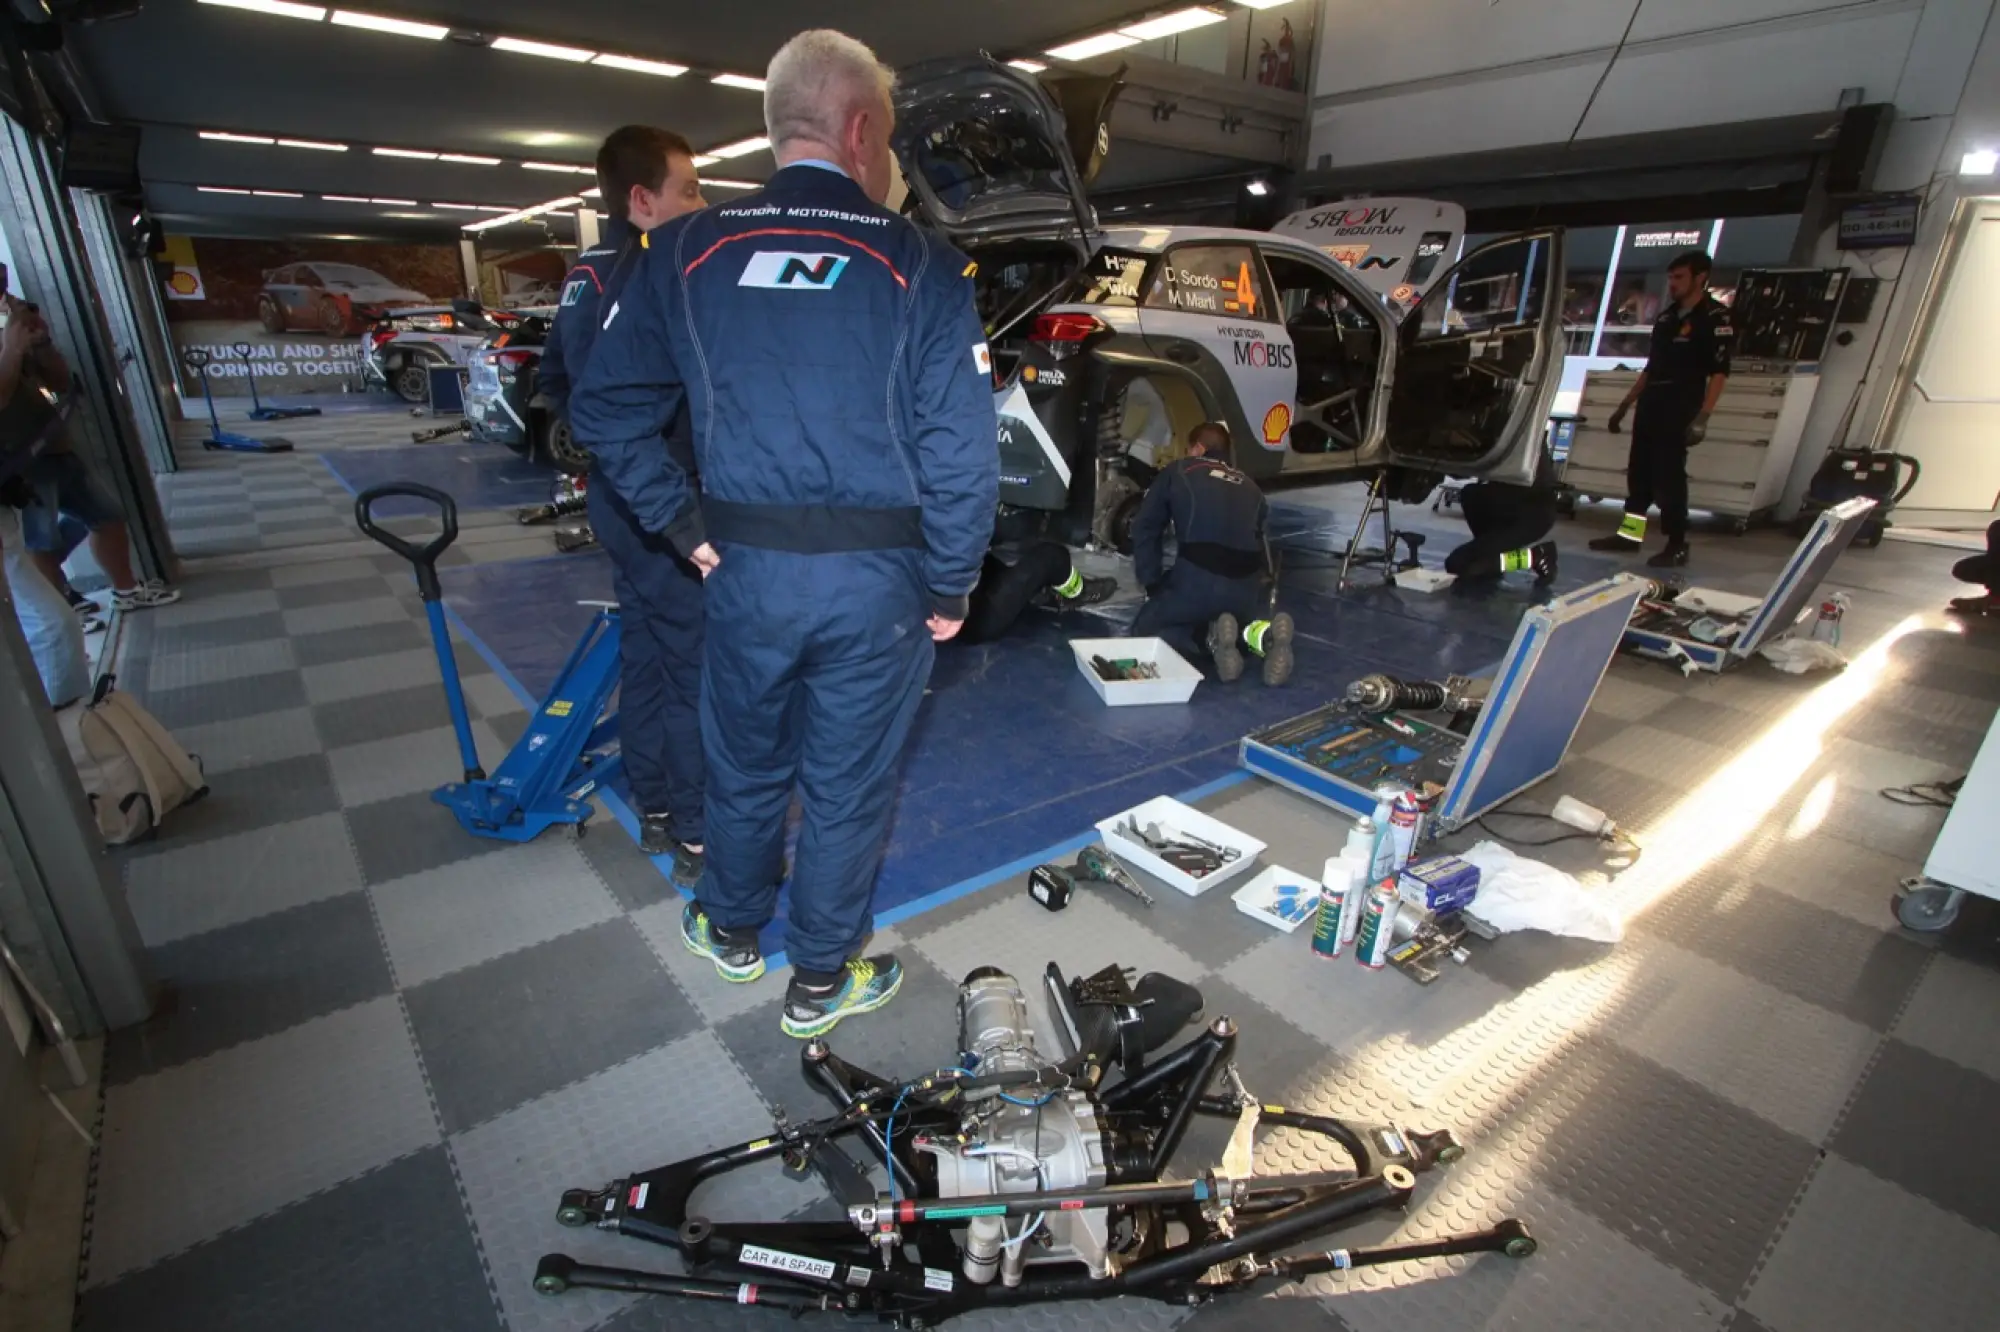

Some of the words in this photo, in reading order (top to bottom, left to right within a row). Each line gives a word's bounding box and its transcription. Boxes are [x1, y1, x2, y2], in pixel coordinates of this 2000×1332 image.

[720, 207, 781, 217] HYUNDAI
[787, 207, 889, 226] MOTORSPORT
[1306, 207, 1397, 229] MOBIS
[1334, 226, 1406, 237] HYUNDAI
[1165, 266, 1179, 283] D.
[1181, 269, 1218, 290] Sordo
[1238, 261, 1256, 315] 4
[283, 344, 321, 358] AND
[1234, 340, 1293, 369] MOBIS
[742, 1248, 768, 1264] CAR
[772, 1254, 786, 1268] #4
[789, 1257, 831, 1276] SPARE
